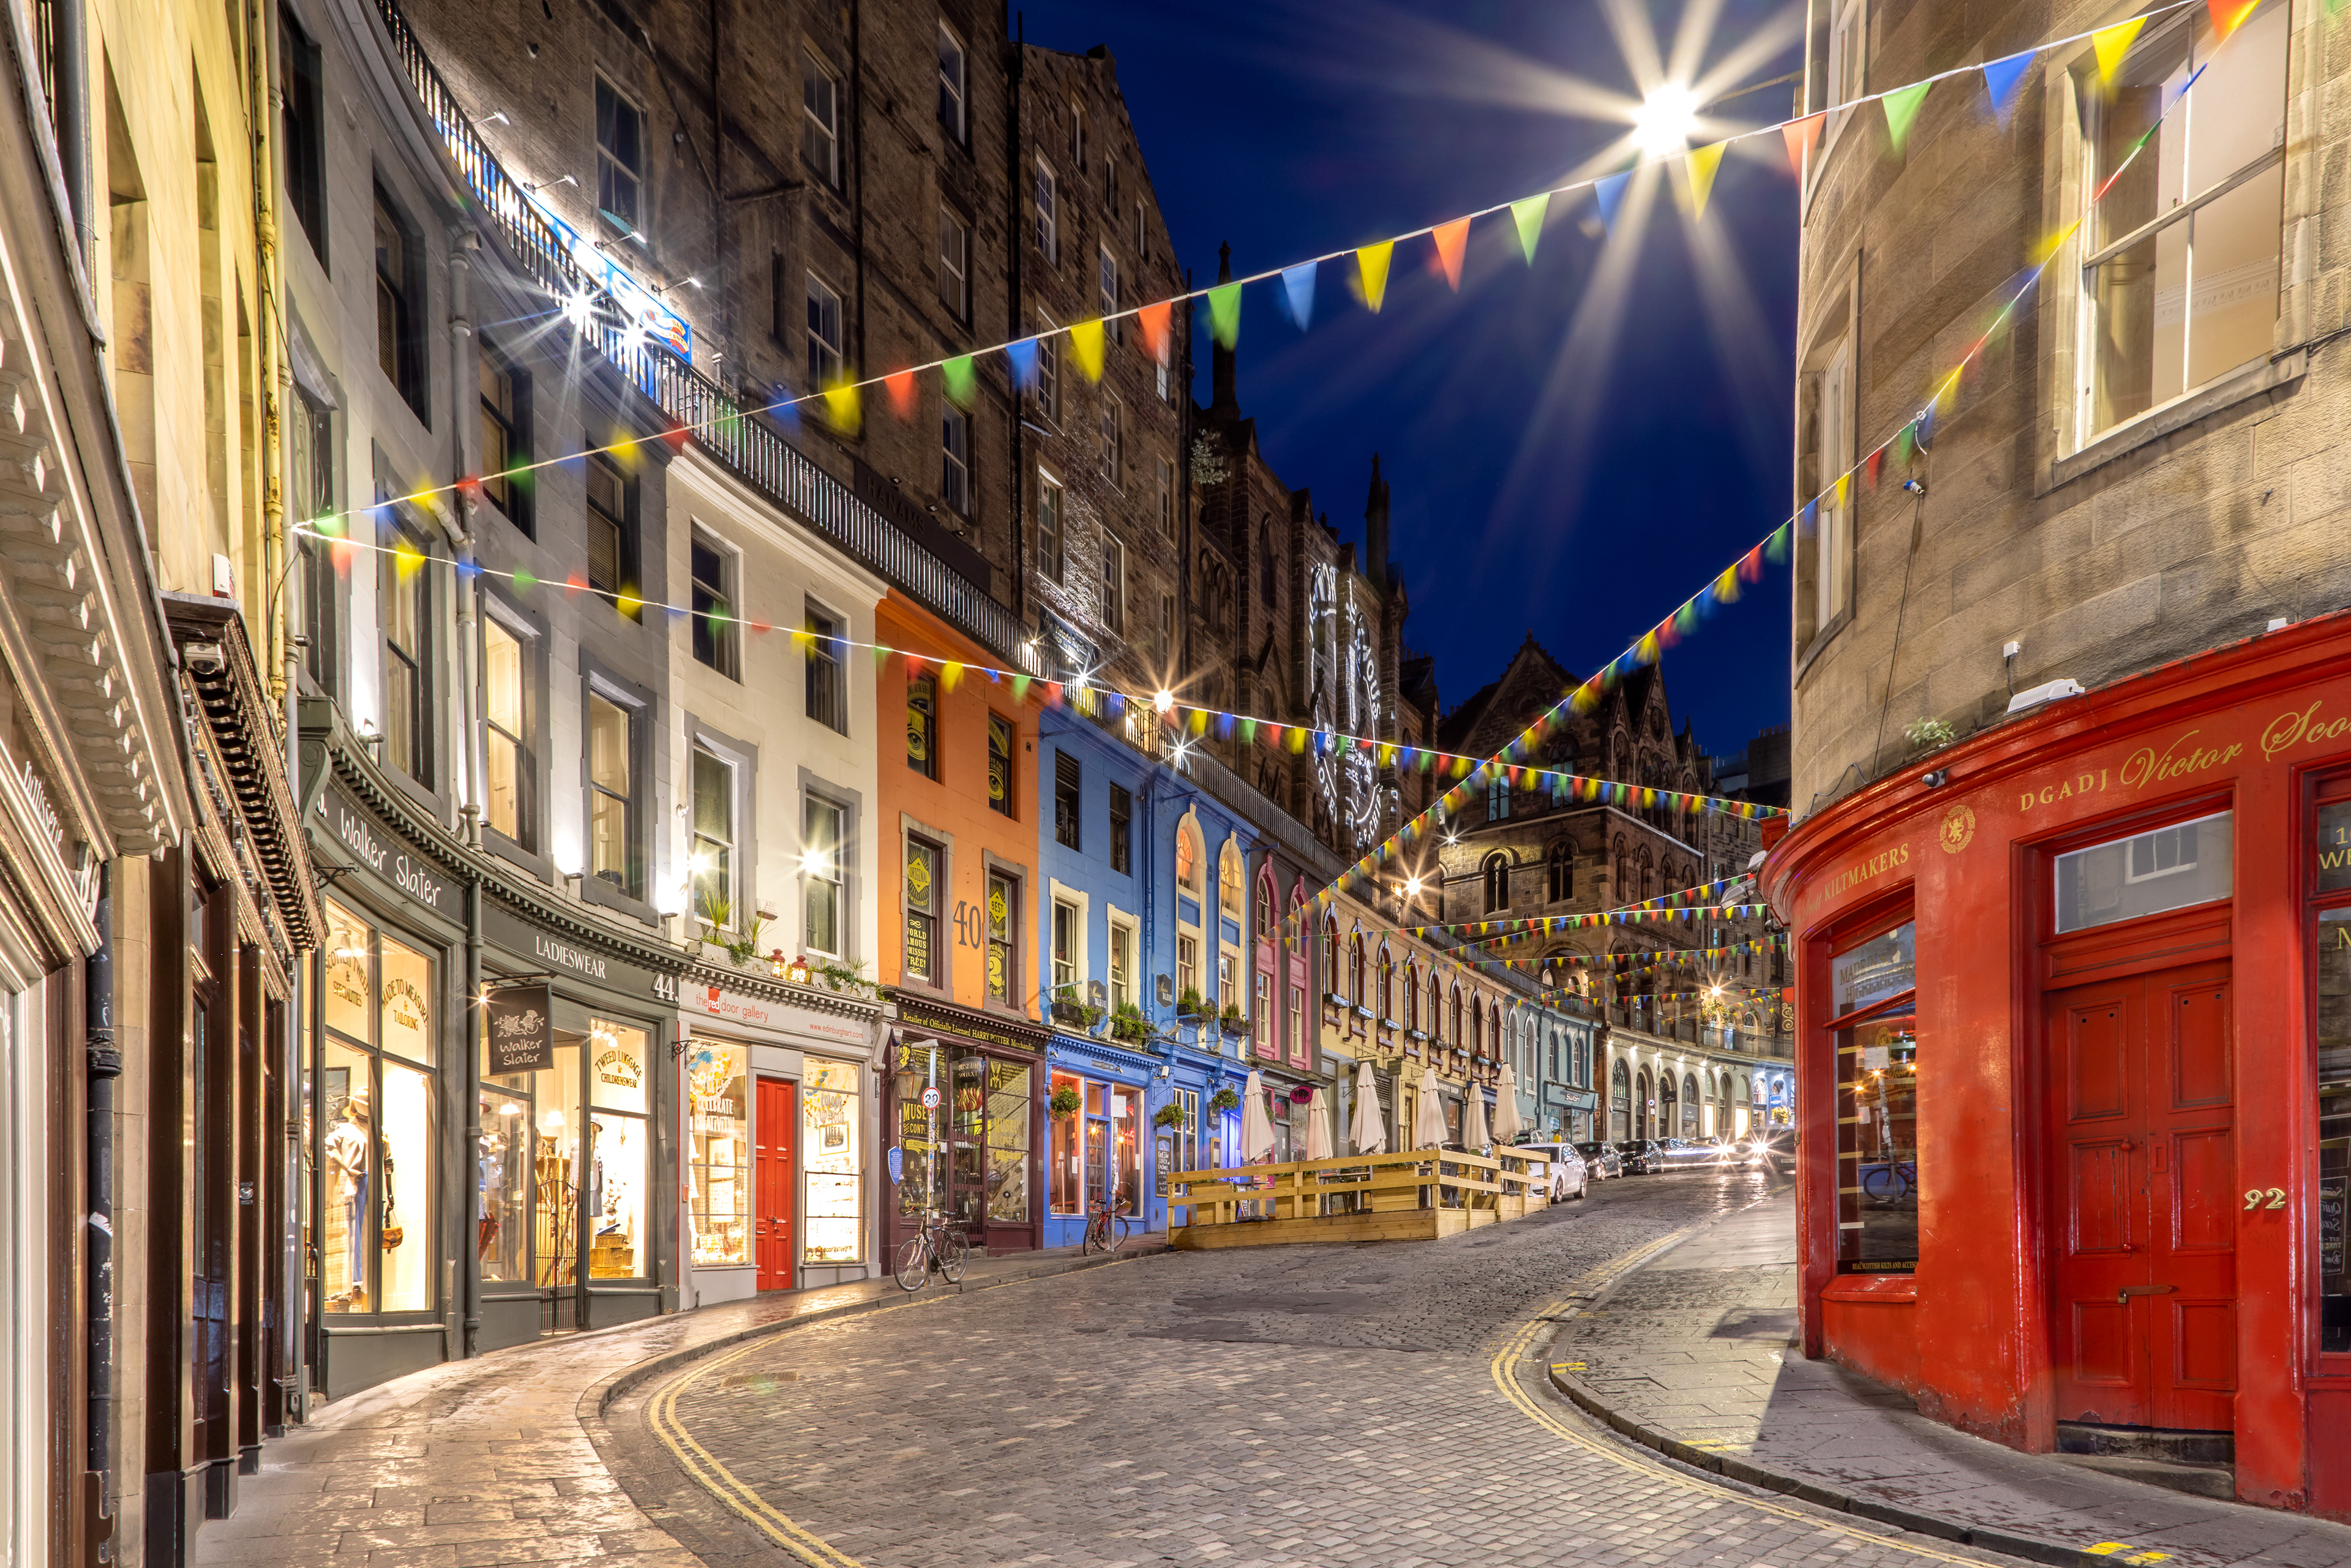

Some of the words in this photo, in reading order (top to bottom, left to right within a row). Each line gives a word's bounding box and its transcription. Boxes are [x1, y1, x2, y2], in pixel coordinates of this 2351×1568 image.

[2020, 768, 2109, 812] DGADJ
[2120, 729, 2243, 789] Victor
[341, 808, 387, 871] Walker
[396, 855, 441, 907] Slater
[909, 866, 928, 883] ORIGINAL
[1824, 842, 1909, 902] KILTMAKERS
[991, 901, 1003, 913] BEST
[953, 900, 981, 950] 40
[907, 937, 927, 949] AMOUS
[989, 944, 1005, 958] PERIOR
[535, 936, 606, 980] LADIESWEAR
[333, 981, 362, 1008] SPECIALITIES
[382, 980, 397, 1010] MADE
[395, 978, 405, 995] TO
[405, 980, 429, 1027] MEASURE
[696, 992, 708, 1008] the
[708, 996, 720, 1010] red
[721, 1000, 739, 1014] door
[742, 1005, 769, 1023] gallery
[393, 1009, 419, 1031] TAILORING
[809, 1022, 864, 1040] www.edinburghart.com
[902, 1011, 922, 1026] Retailer
[923, 1017, 929, 1026] of
[929, 1018, 952, 1033] Officially
[951, 1024, 972, 1037] Licensed
[972, 1029, 990, 1041] HARRY
[990, 1033, 1010, 1046] POTTER
[1011, 1038, 1036, 1052] Merchandise
[594, 1052, 617, 1073] TWEED
[617, 1049, 643, 1081] LUGGAGE
[601, 1073, 638, 1089] CHILDRENSWEAR
[1450, 1086, 1459, 1095] SHOP
[821, 1093, 843, 1109] COLOUR
[925, 1093, 939, 1103] 20
[902, 1102, 927, 1122] MUSE
[910, 1123, 927, 1135] CONTE
[2243, 1188, 2287, 1210] 92
